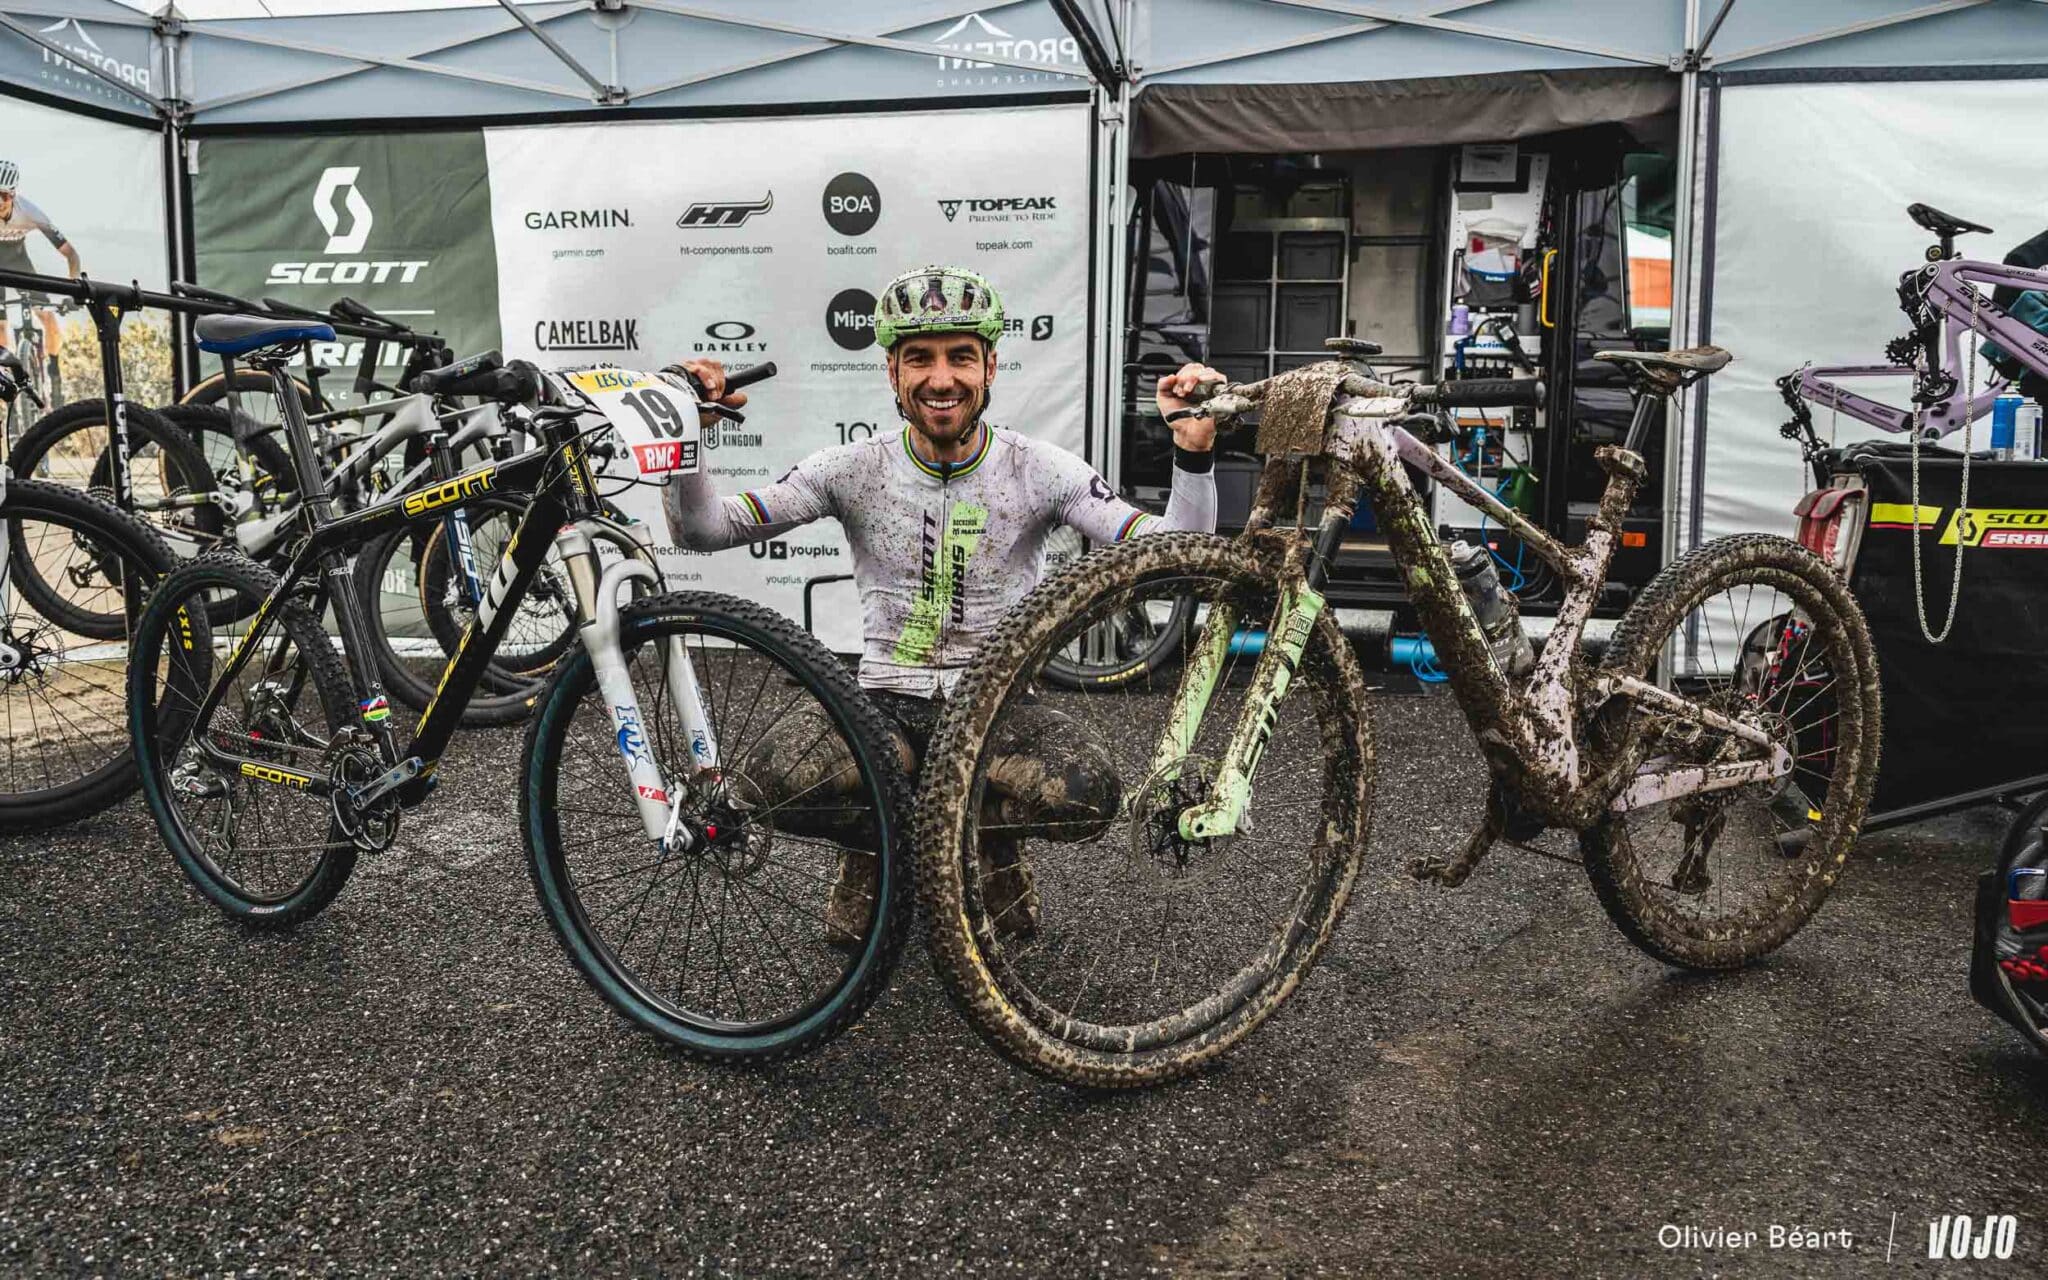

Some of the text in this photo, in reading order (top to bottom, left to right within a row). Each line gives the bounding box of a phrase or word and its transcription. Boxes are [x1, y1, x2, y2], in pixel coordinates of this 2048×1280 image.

[831, 196, 873, 214] BOA
[965, 197, 1056, 211] TOPEAK
[525, 209, 632, 230] GARMIN
[552, 248, 604, 258] garmin.com
[680, 245, 773, 256] ht-components.com
[827, 245, 877, 255] boafit.com
[976, 240, 1033, 251] topeak.com
[265, 261, 429, 284] SCOTT
[834, 310, 875, 331] Mips
[535, 319, 638, 351] CAMELBAK
[694, 342, 767, 352] OAKLEY
[620, 389, 684, 439] 19
[722, 434, 762, 447] KINGDOM
[644, 445, 676, 471] RMC
[562, 444, 586, 497] SCOTT
[403, 467, 497, 516] SCOTT
[790, 545, 839, 558] youplus
[922, 509, 936, 605] SCOTT
[952, 544, 965, 624] SRAM
[177, 604, 193, 651] XXIS
[240, 762, 311, 790] SCOTT
